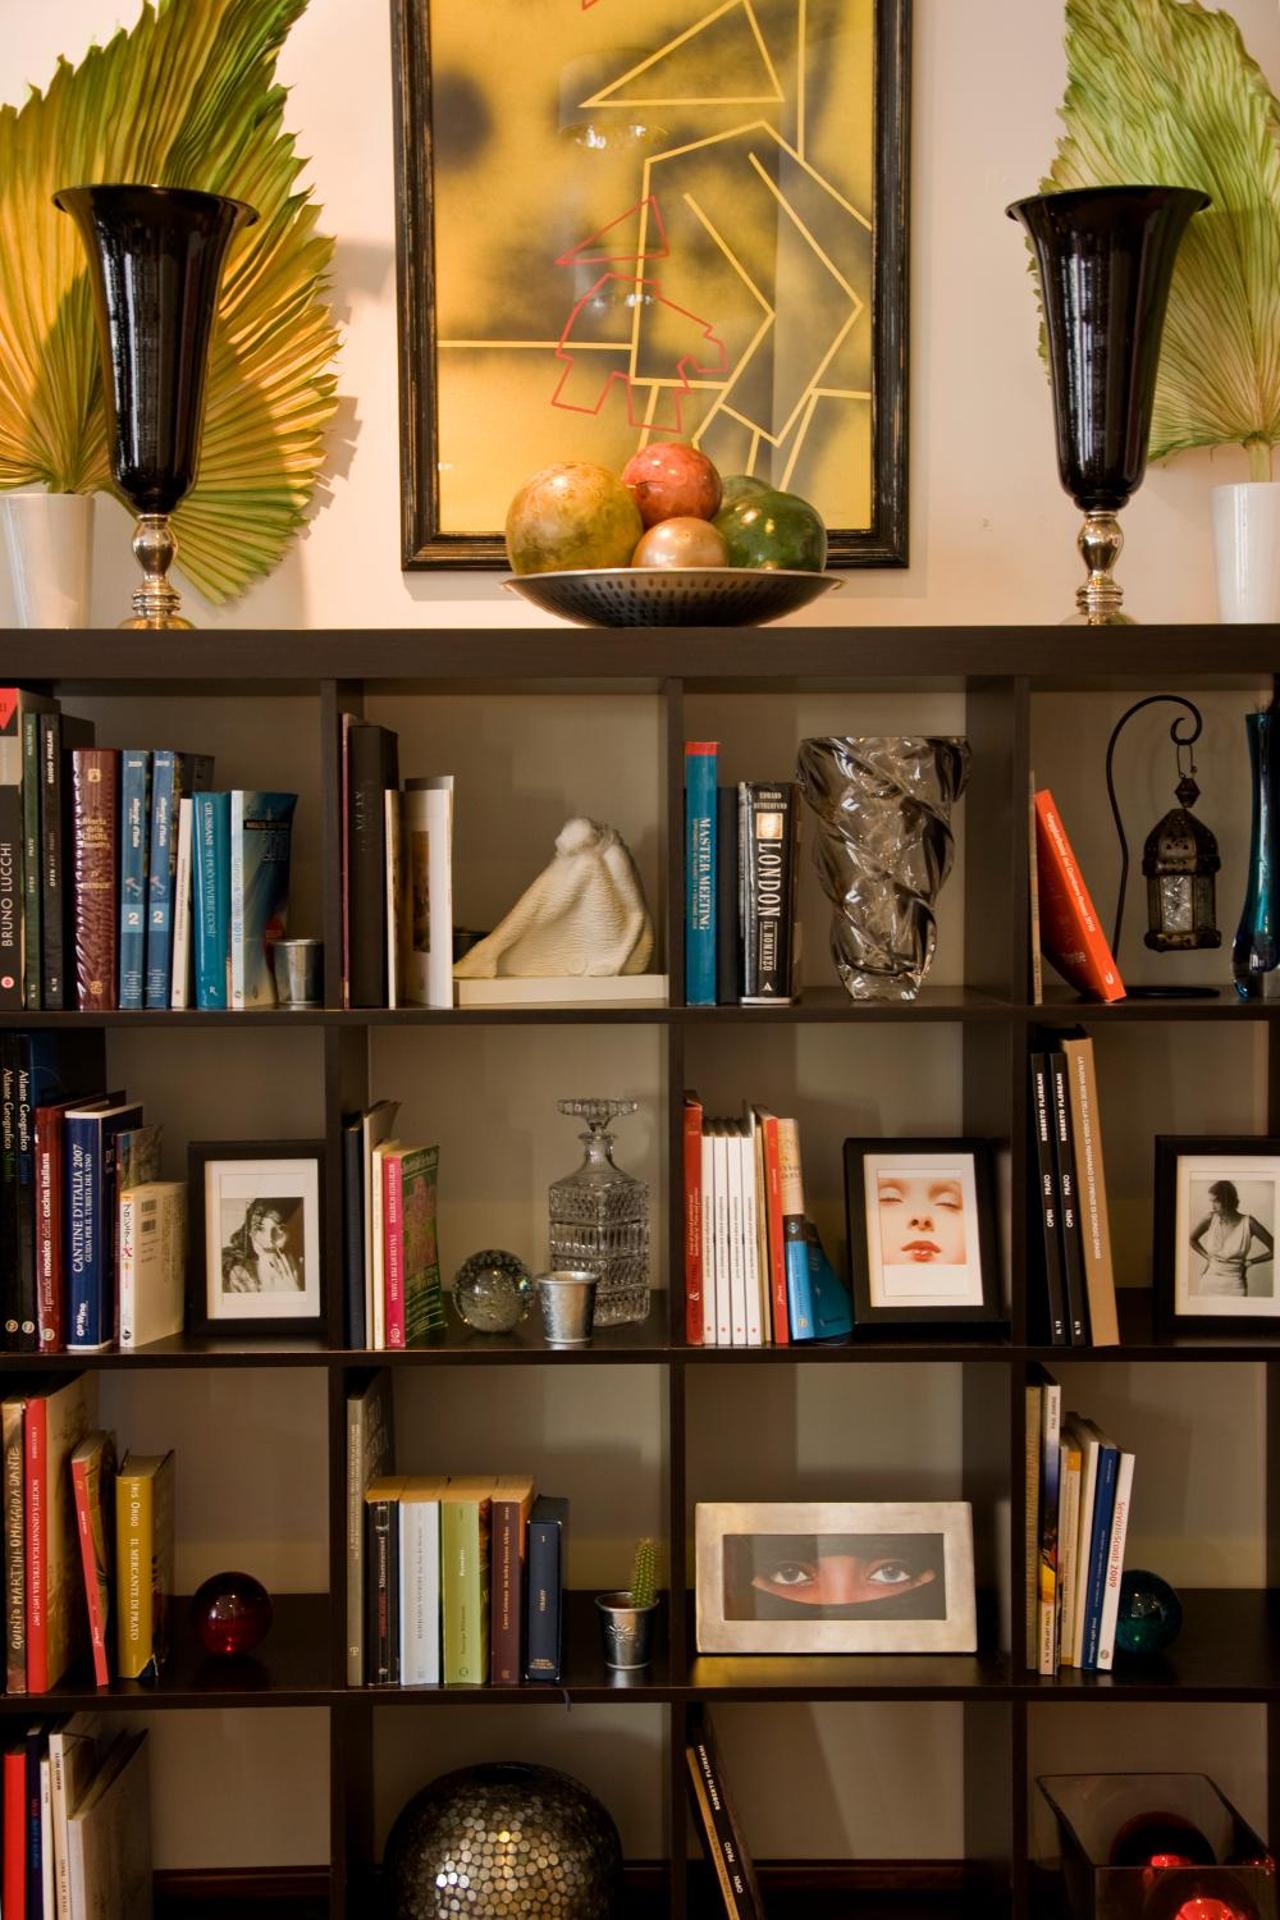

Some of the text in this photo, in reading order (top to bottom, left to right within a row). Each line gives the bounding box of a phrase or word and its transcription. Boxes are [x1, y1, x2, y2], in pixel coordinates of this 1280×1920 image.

[699, 818, 712, 930] MASTER MEETING
[758, 842, 782, 916] LONDON
[1, 842, 13, 947] BRUNO LUCCHI
[128, 912, 138, 925] 2
[154, 910, 164, 924] 2
[762, 921, 774, 971] IL ROMANZO
[3, 1068, 14, 1100] Atlante
[18, 1070, 30, 1101] Atlante
[2, 1102, 14, 1149] Geografico
[18, 1104, 30, 1151] Geografico
[1039, 1108, 1048, 1141] ROBERTO
[1059, 1108, 1068, 1141] ROBERTO
[41, 1153, 50, 1188] italiana
[42, 1189, 50, 1218] cucina
[72, 1144, 83, 1272] CANTINE D'ITALIA 2007
[42, 1219, 51, 1238] della
[42, 1240, 52, 1276] mosaico
[42, 1278, 54, 1305] grande
[690, 1292, 700, 1301] &
[8, 1447, 20, 1486] DANTE
[12, 1489, 20, 1497] A
[130, 1502, 141, 1526] ORIGO
[32, 1514, 40, 1560] GINNASTICA
[131, 1549, 140, 1596] MERCANTE
[1108, 1564, 1118, 1588] 2009
[131, 1599, 140, 1609] DI
[10, 1608, 24, 1650] QUINTO
[131, 1611, 140, 1640] PRATO
[708, 1780, 720, 1810] ROBERTO
[724, 1842, 743, 1893] OPEN PRATO
